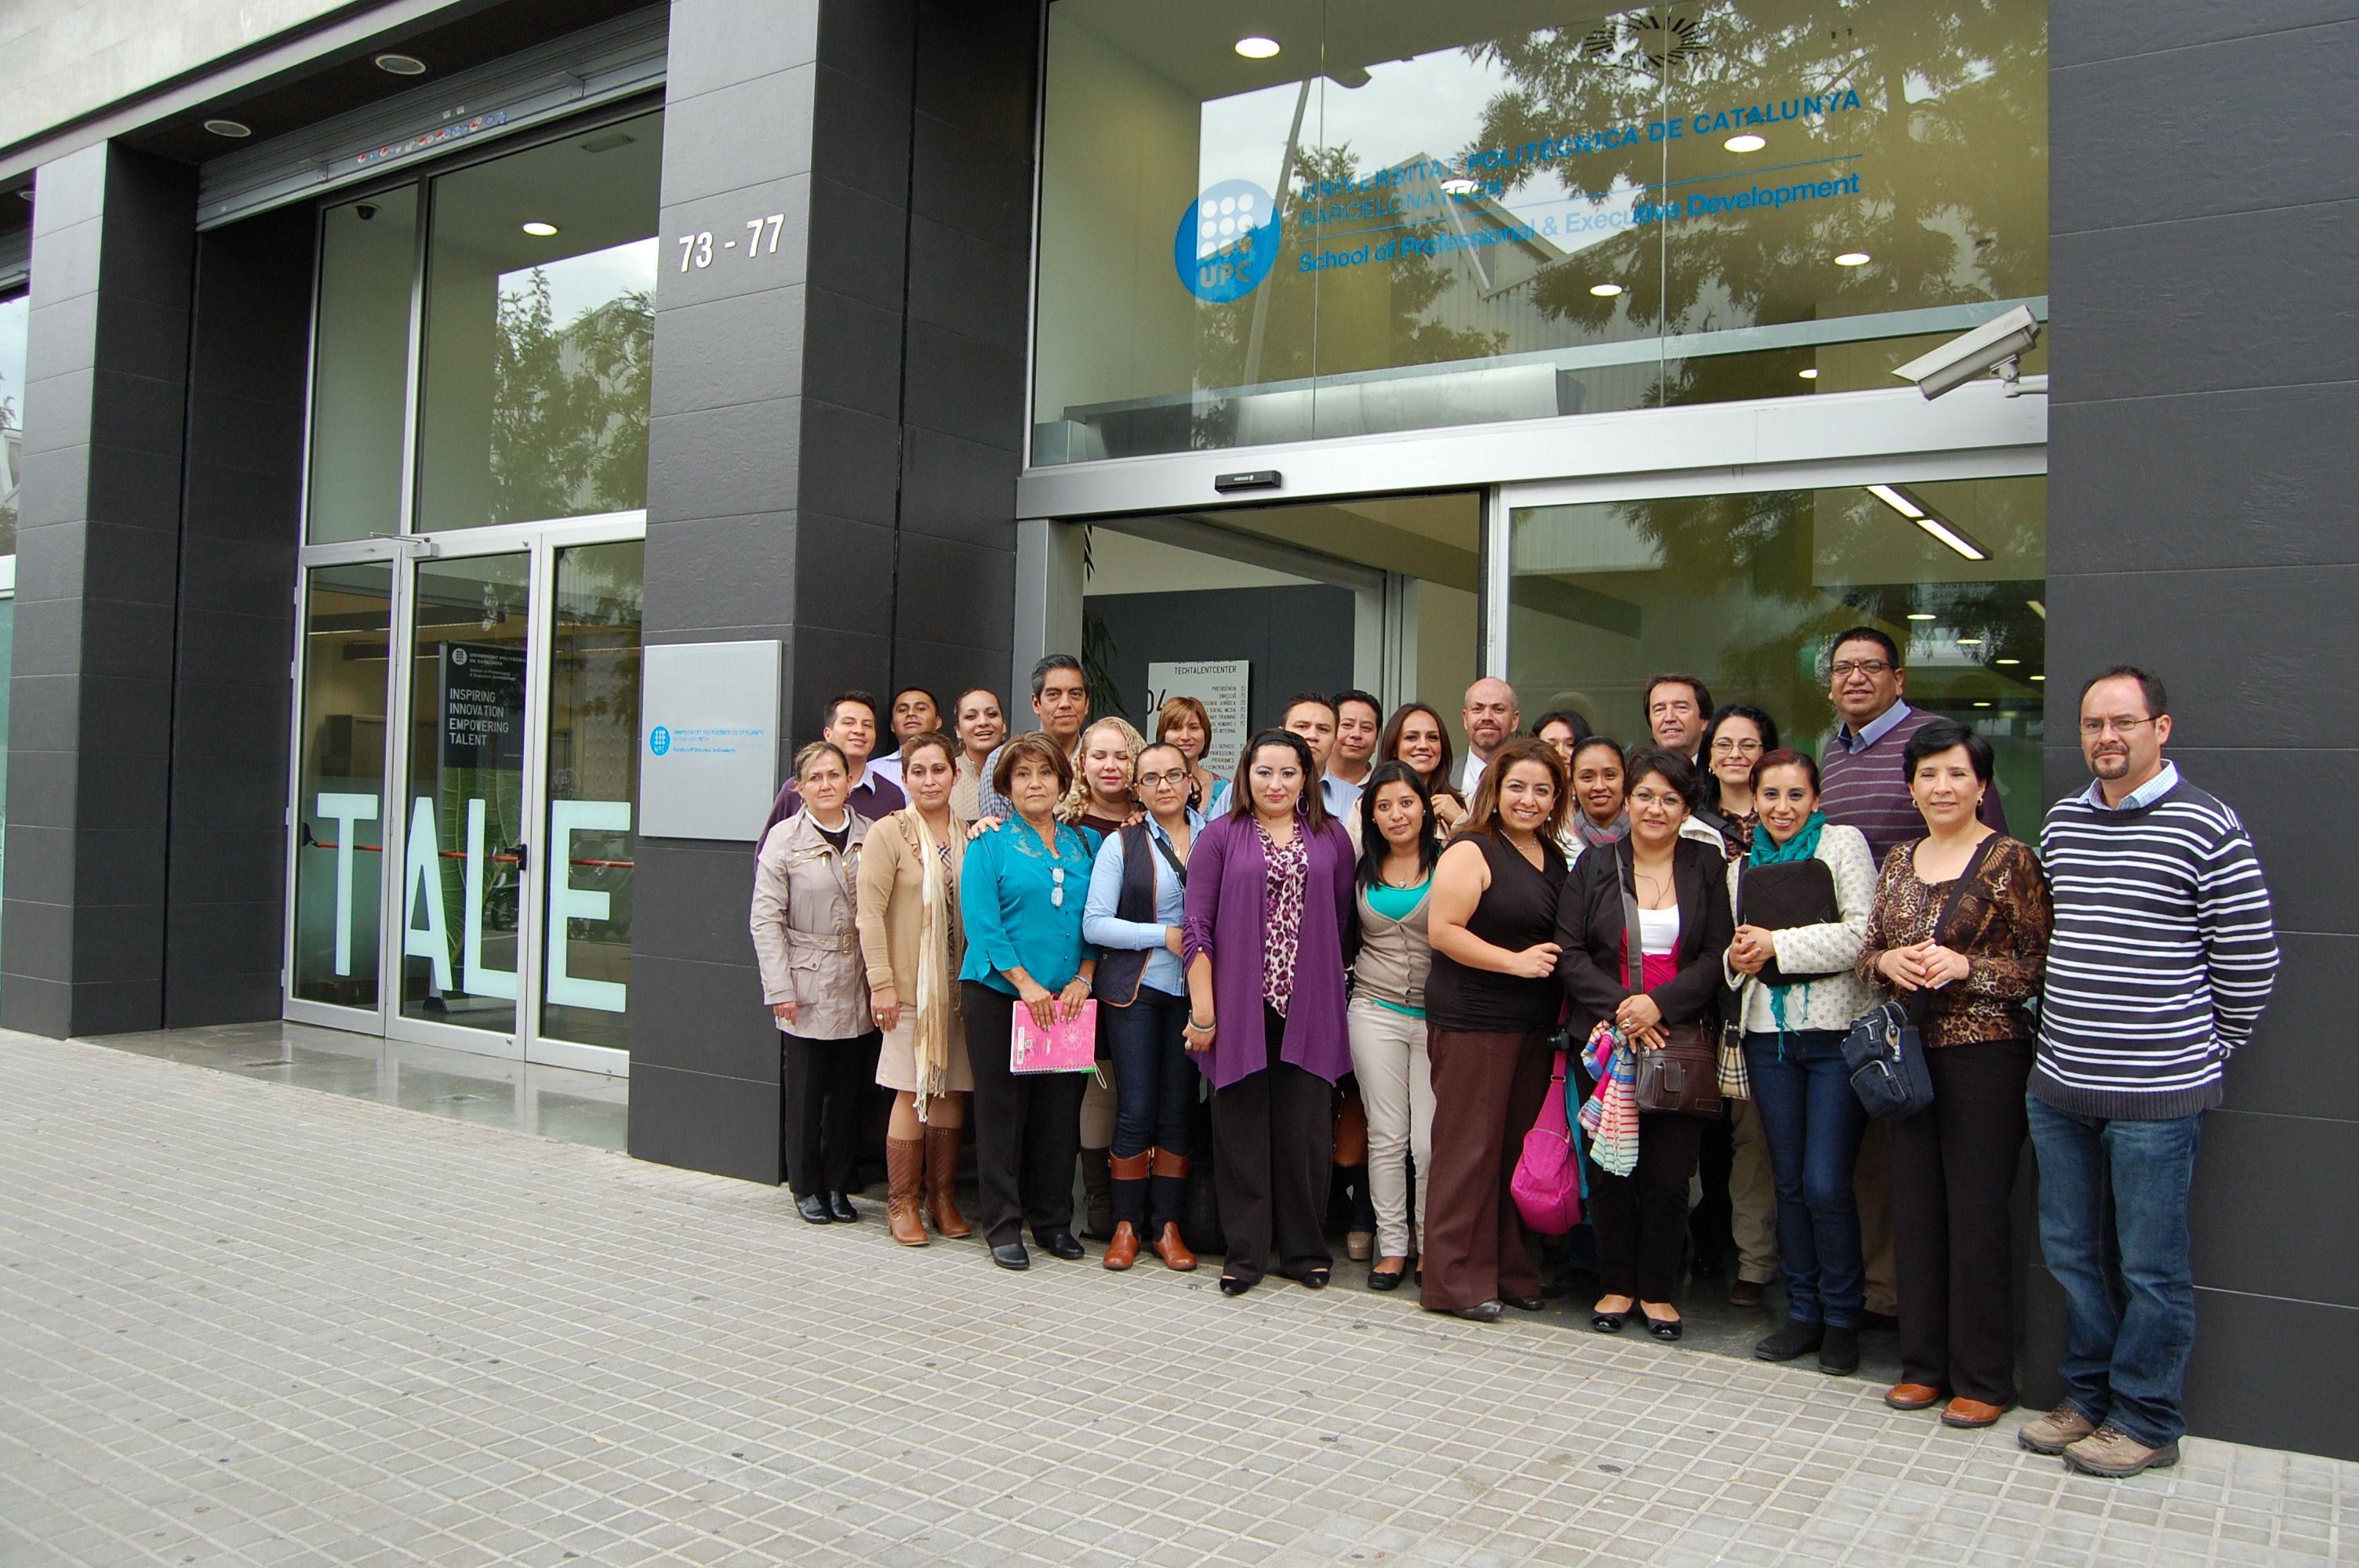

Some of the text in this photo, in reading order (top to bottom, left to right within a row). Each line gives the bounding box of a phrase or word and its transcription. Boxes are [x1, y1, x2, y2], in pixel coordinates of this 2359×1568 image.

[1302, 89, 1861, 200] UNIVERSITAT POLITÈCNICA DE CATALUNYA
[1301, 178, 1502, 228] BARCELONATECH
[1299, 172, 1860, 273] School of Professional & Executive Development
[679, 231, 713, 273] 73
[747, 213, 785, 258] 77
[1200, 260, 1251, 288] UPC
[1175, 666, 1237, 675] TECHTALENTCENTER
[450, 688, 496, 702] INSPIRING
[449, 702, 504, 717] INNOVATION
[449, 718, 509, 733] EMPOWERING
[449, 733, 487, 746] TALENT
